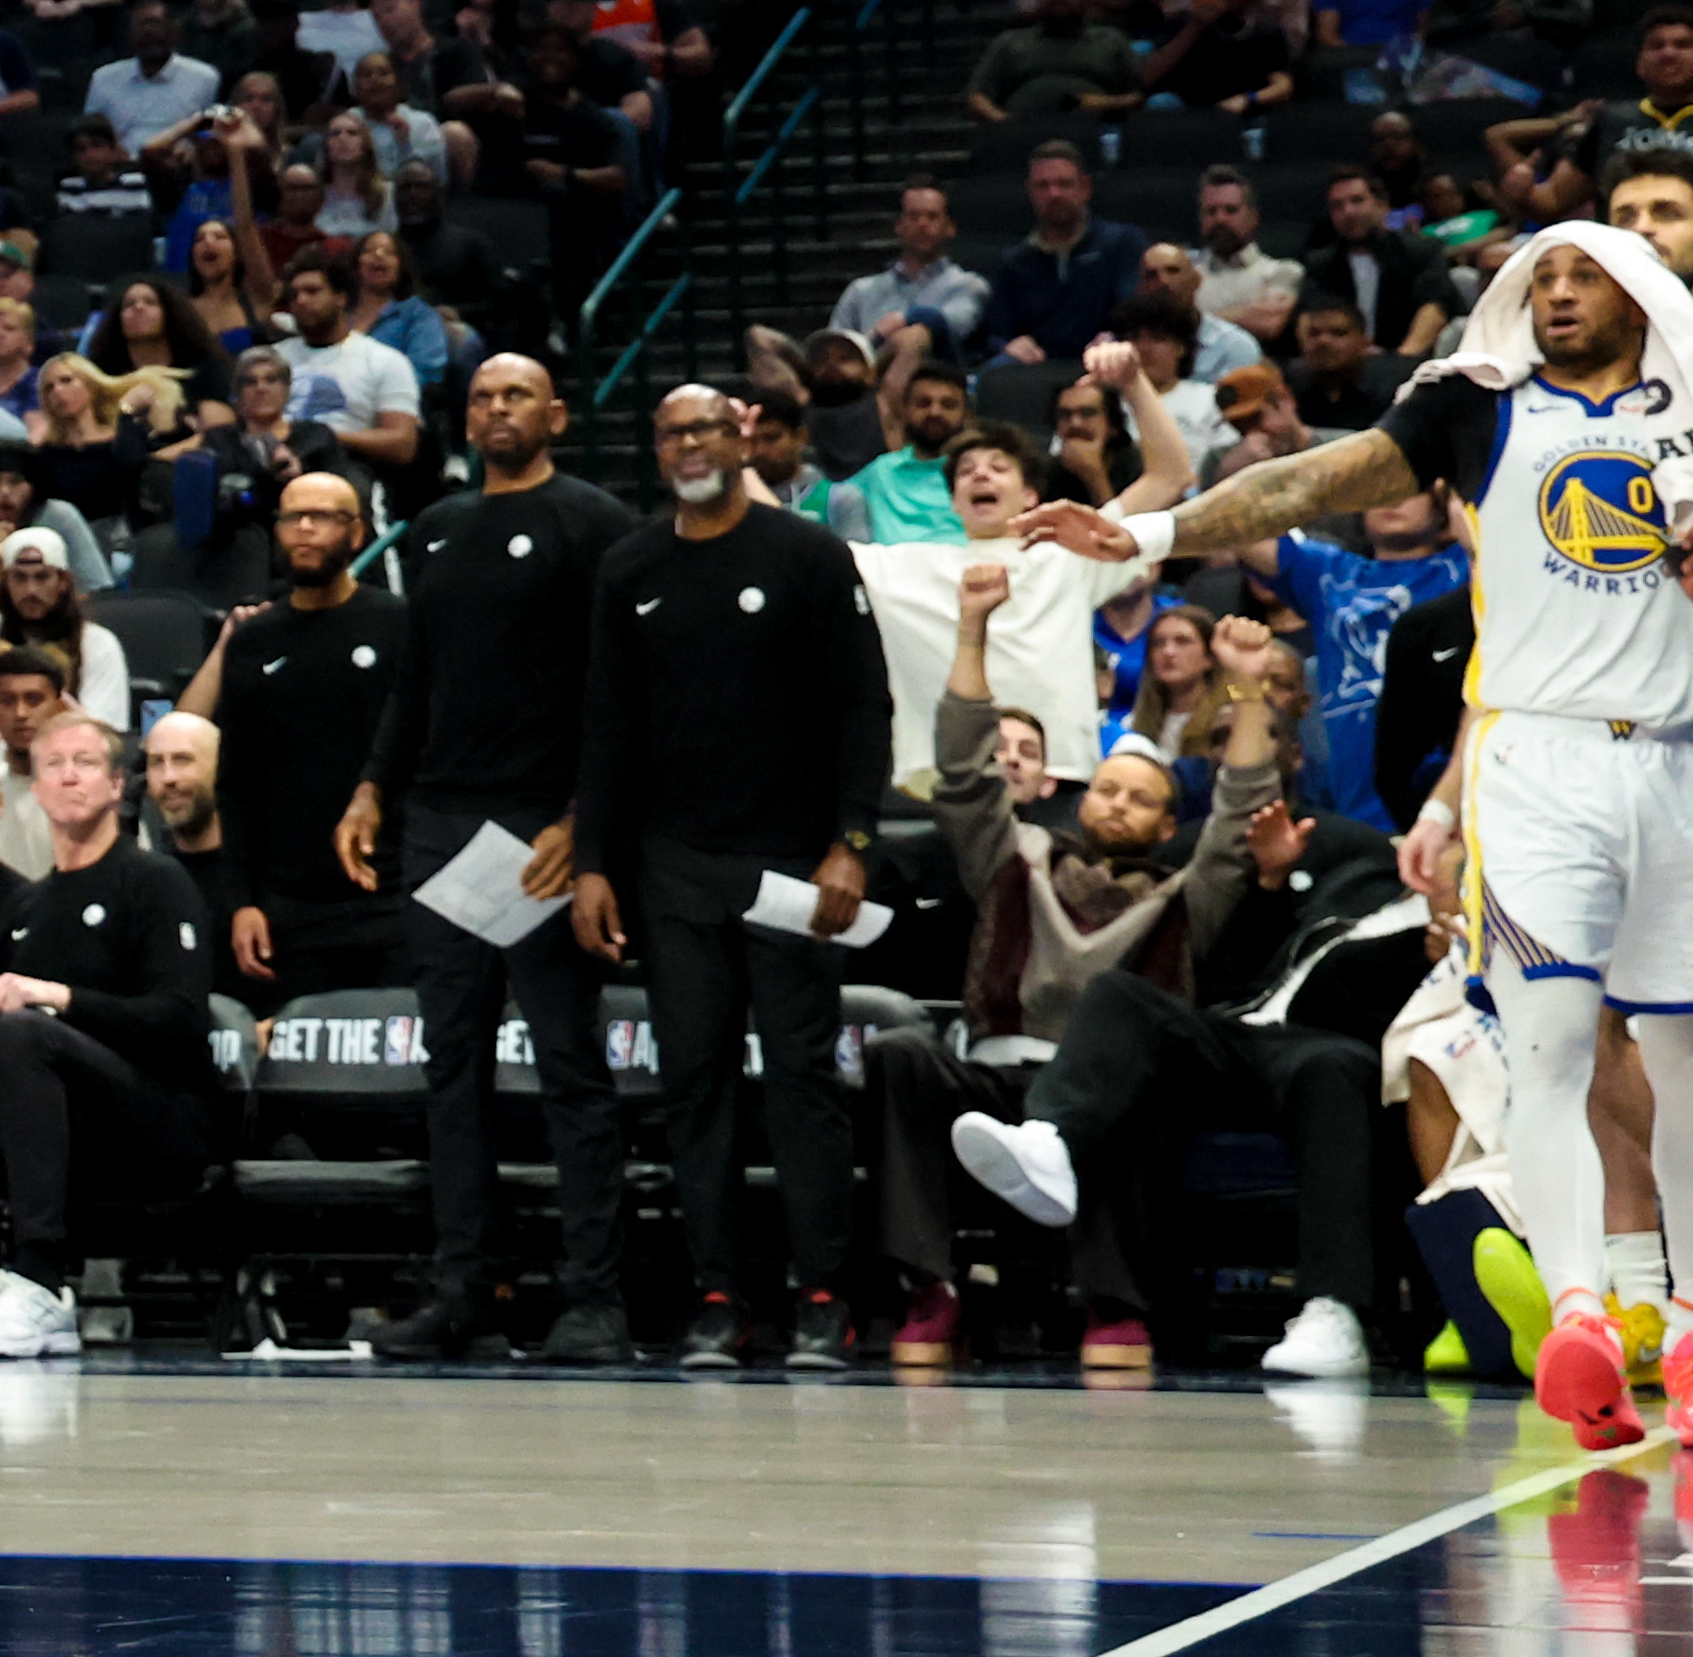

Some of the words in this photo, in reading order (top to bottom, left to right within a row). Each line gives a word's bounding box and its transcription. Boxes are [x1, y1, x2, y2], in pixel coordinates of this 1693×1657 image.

[1627, 476, 1655, 515] 0
[268, 1017, 324, 1063] GET
[326, 1018, 382, 1065] THE
